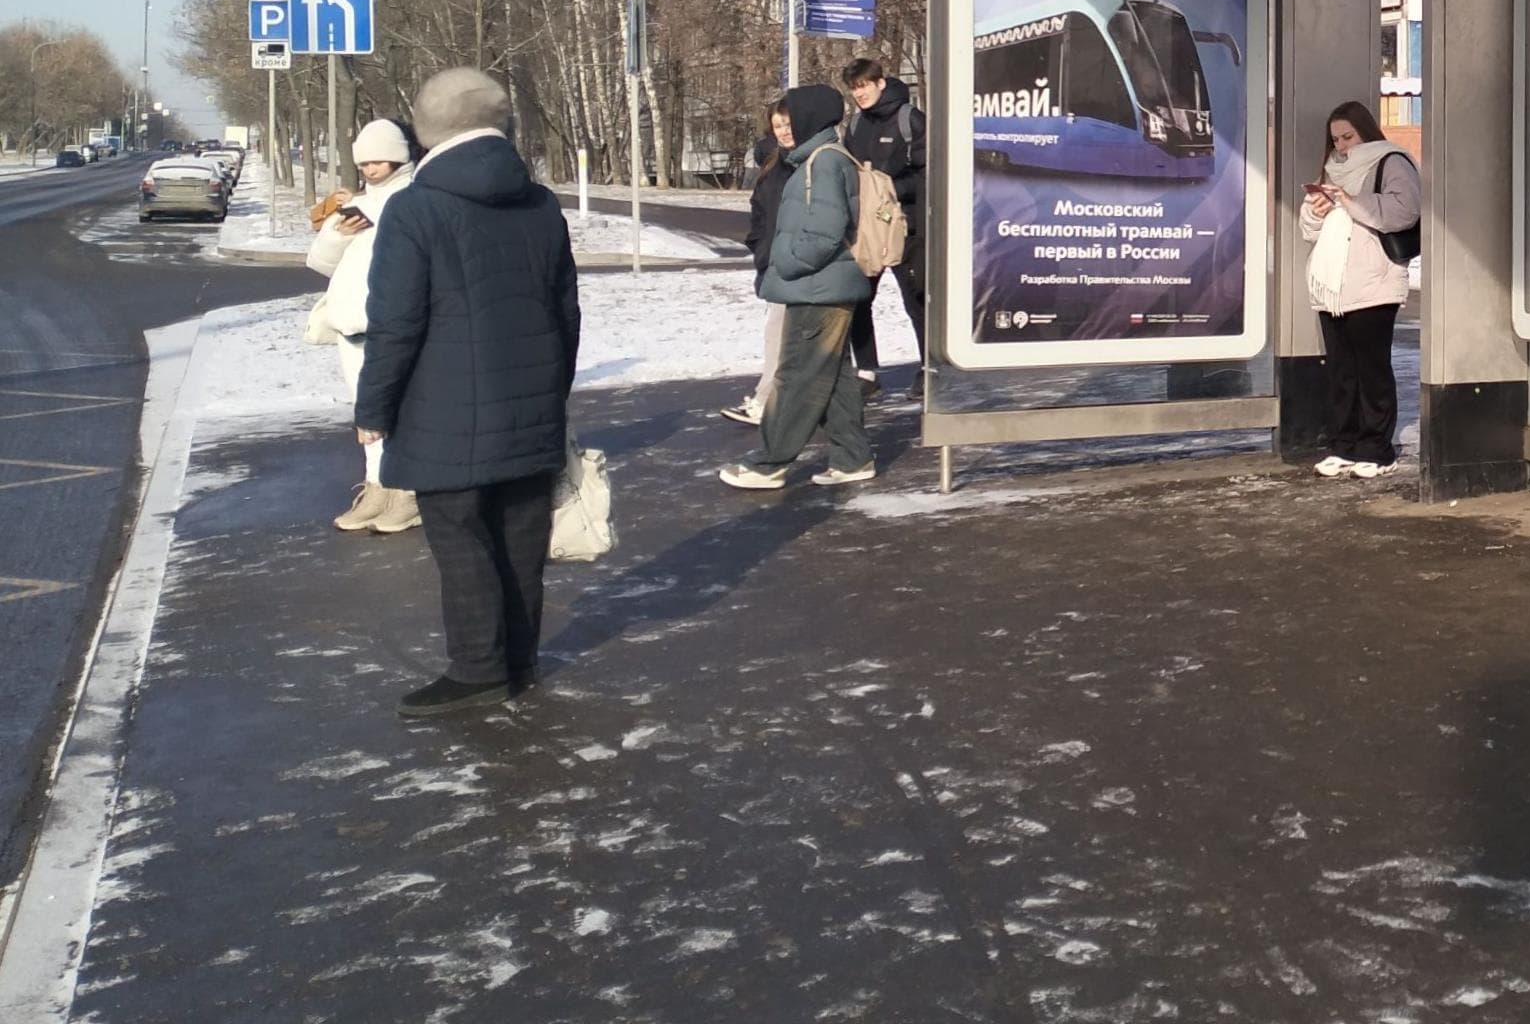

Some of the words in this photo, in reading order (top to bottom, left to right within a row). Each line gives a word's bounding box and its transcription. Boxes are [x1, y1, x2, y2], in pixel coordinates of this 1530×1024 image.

[261, 5, 285, 36] P
[1054, 200, 1164, 218] Московский
[998, 221, 1116, 238] беспилотный
[1120, 225, 1192, 240] трамвай
[1034, 244, 1102, 261] первый
[1106, 247, 1116, 259] в
[1121, 244, 1180, 260] России
[1020, 274, 1077, 285] Разработка
[1080, 274, 1150, 286] Правительства
[1153, 275, 1191, 285] Москвы
